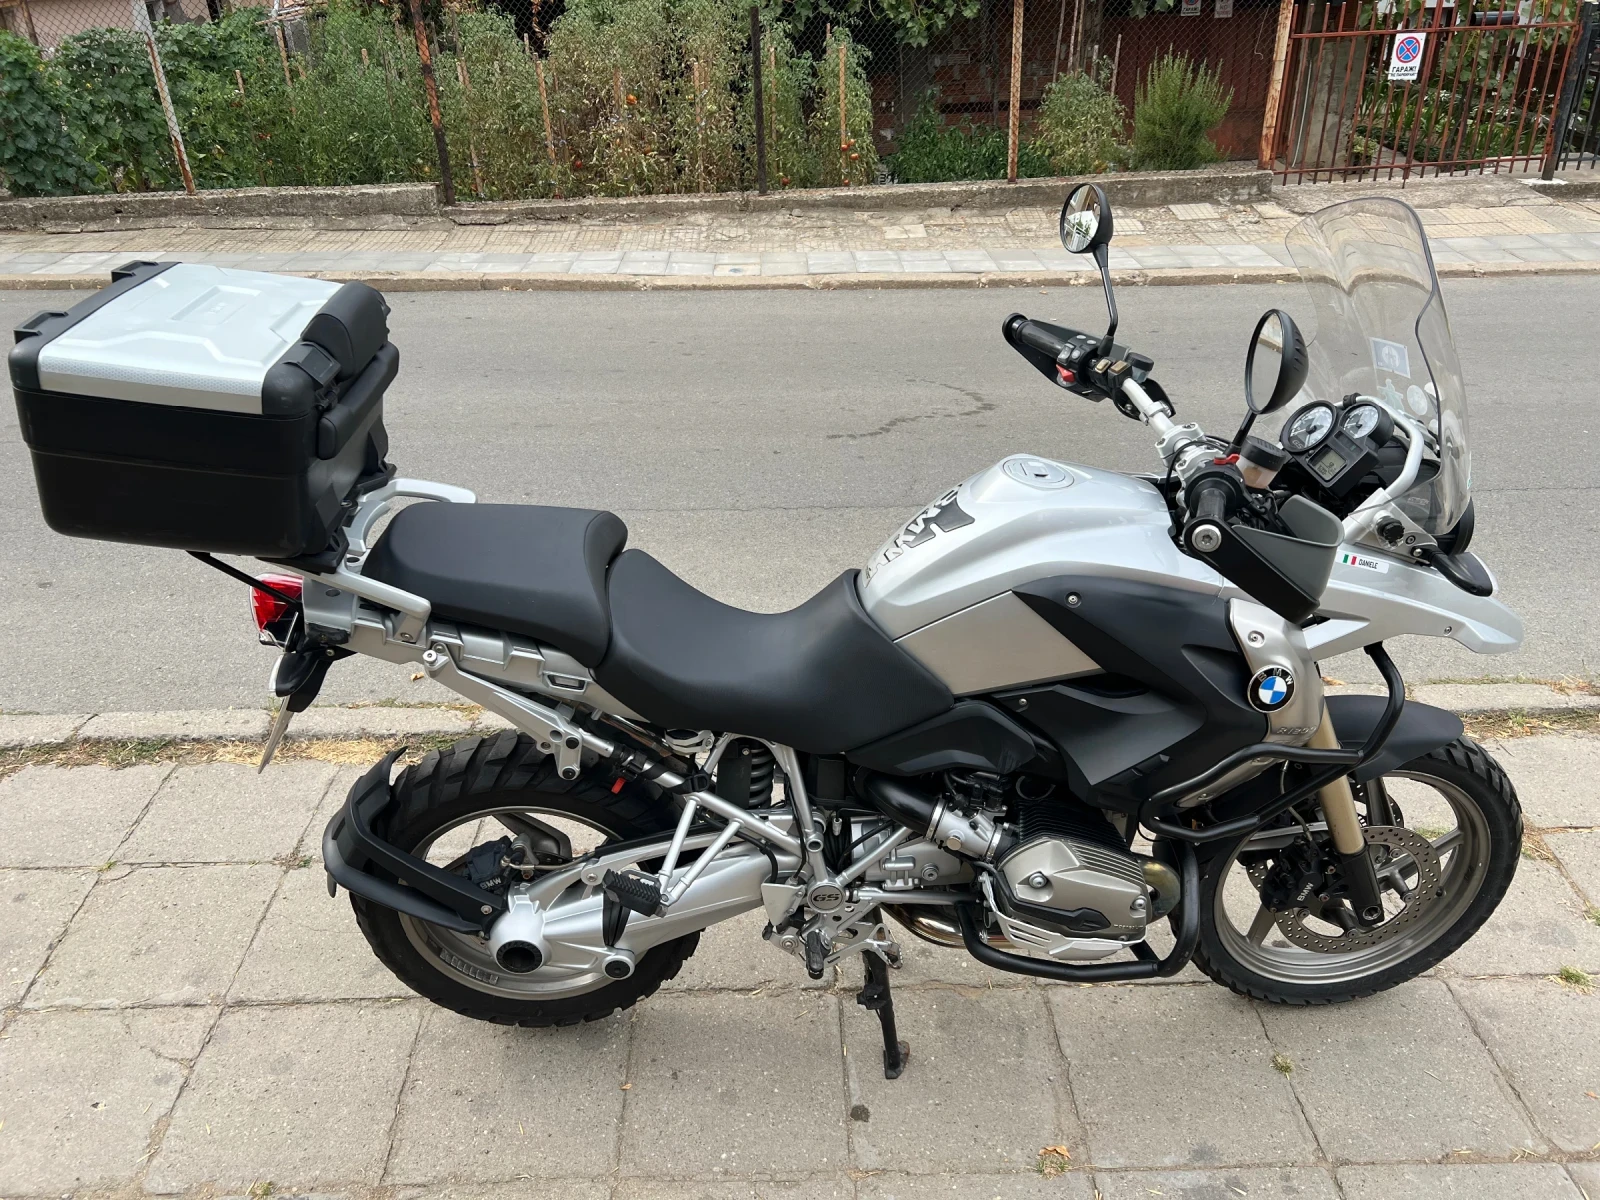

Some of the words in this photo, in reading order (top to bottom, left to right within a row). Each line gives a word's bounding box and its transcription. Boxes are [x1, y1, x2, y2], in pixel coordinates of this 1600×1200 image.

[1359, 559, 1378, 569] DANIELE
[1257, 667, 1294, 685] BMW
[480, 878, 502, 890] BMW
[812, 893, 841, 901] GS
[1296, 882, 1314, 901] BMW
